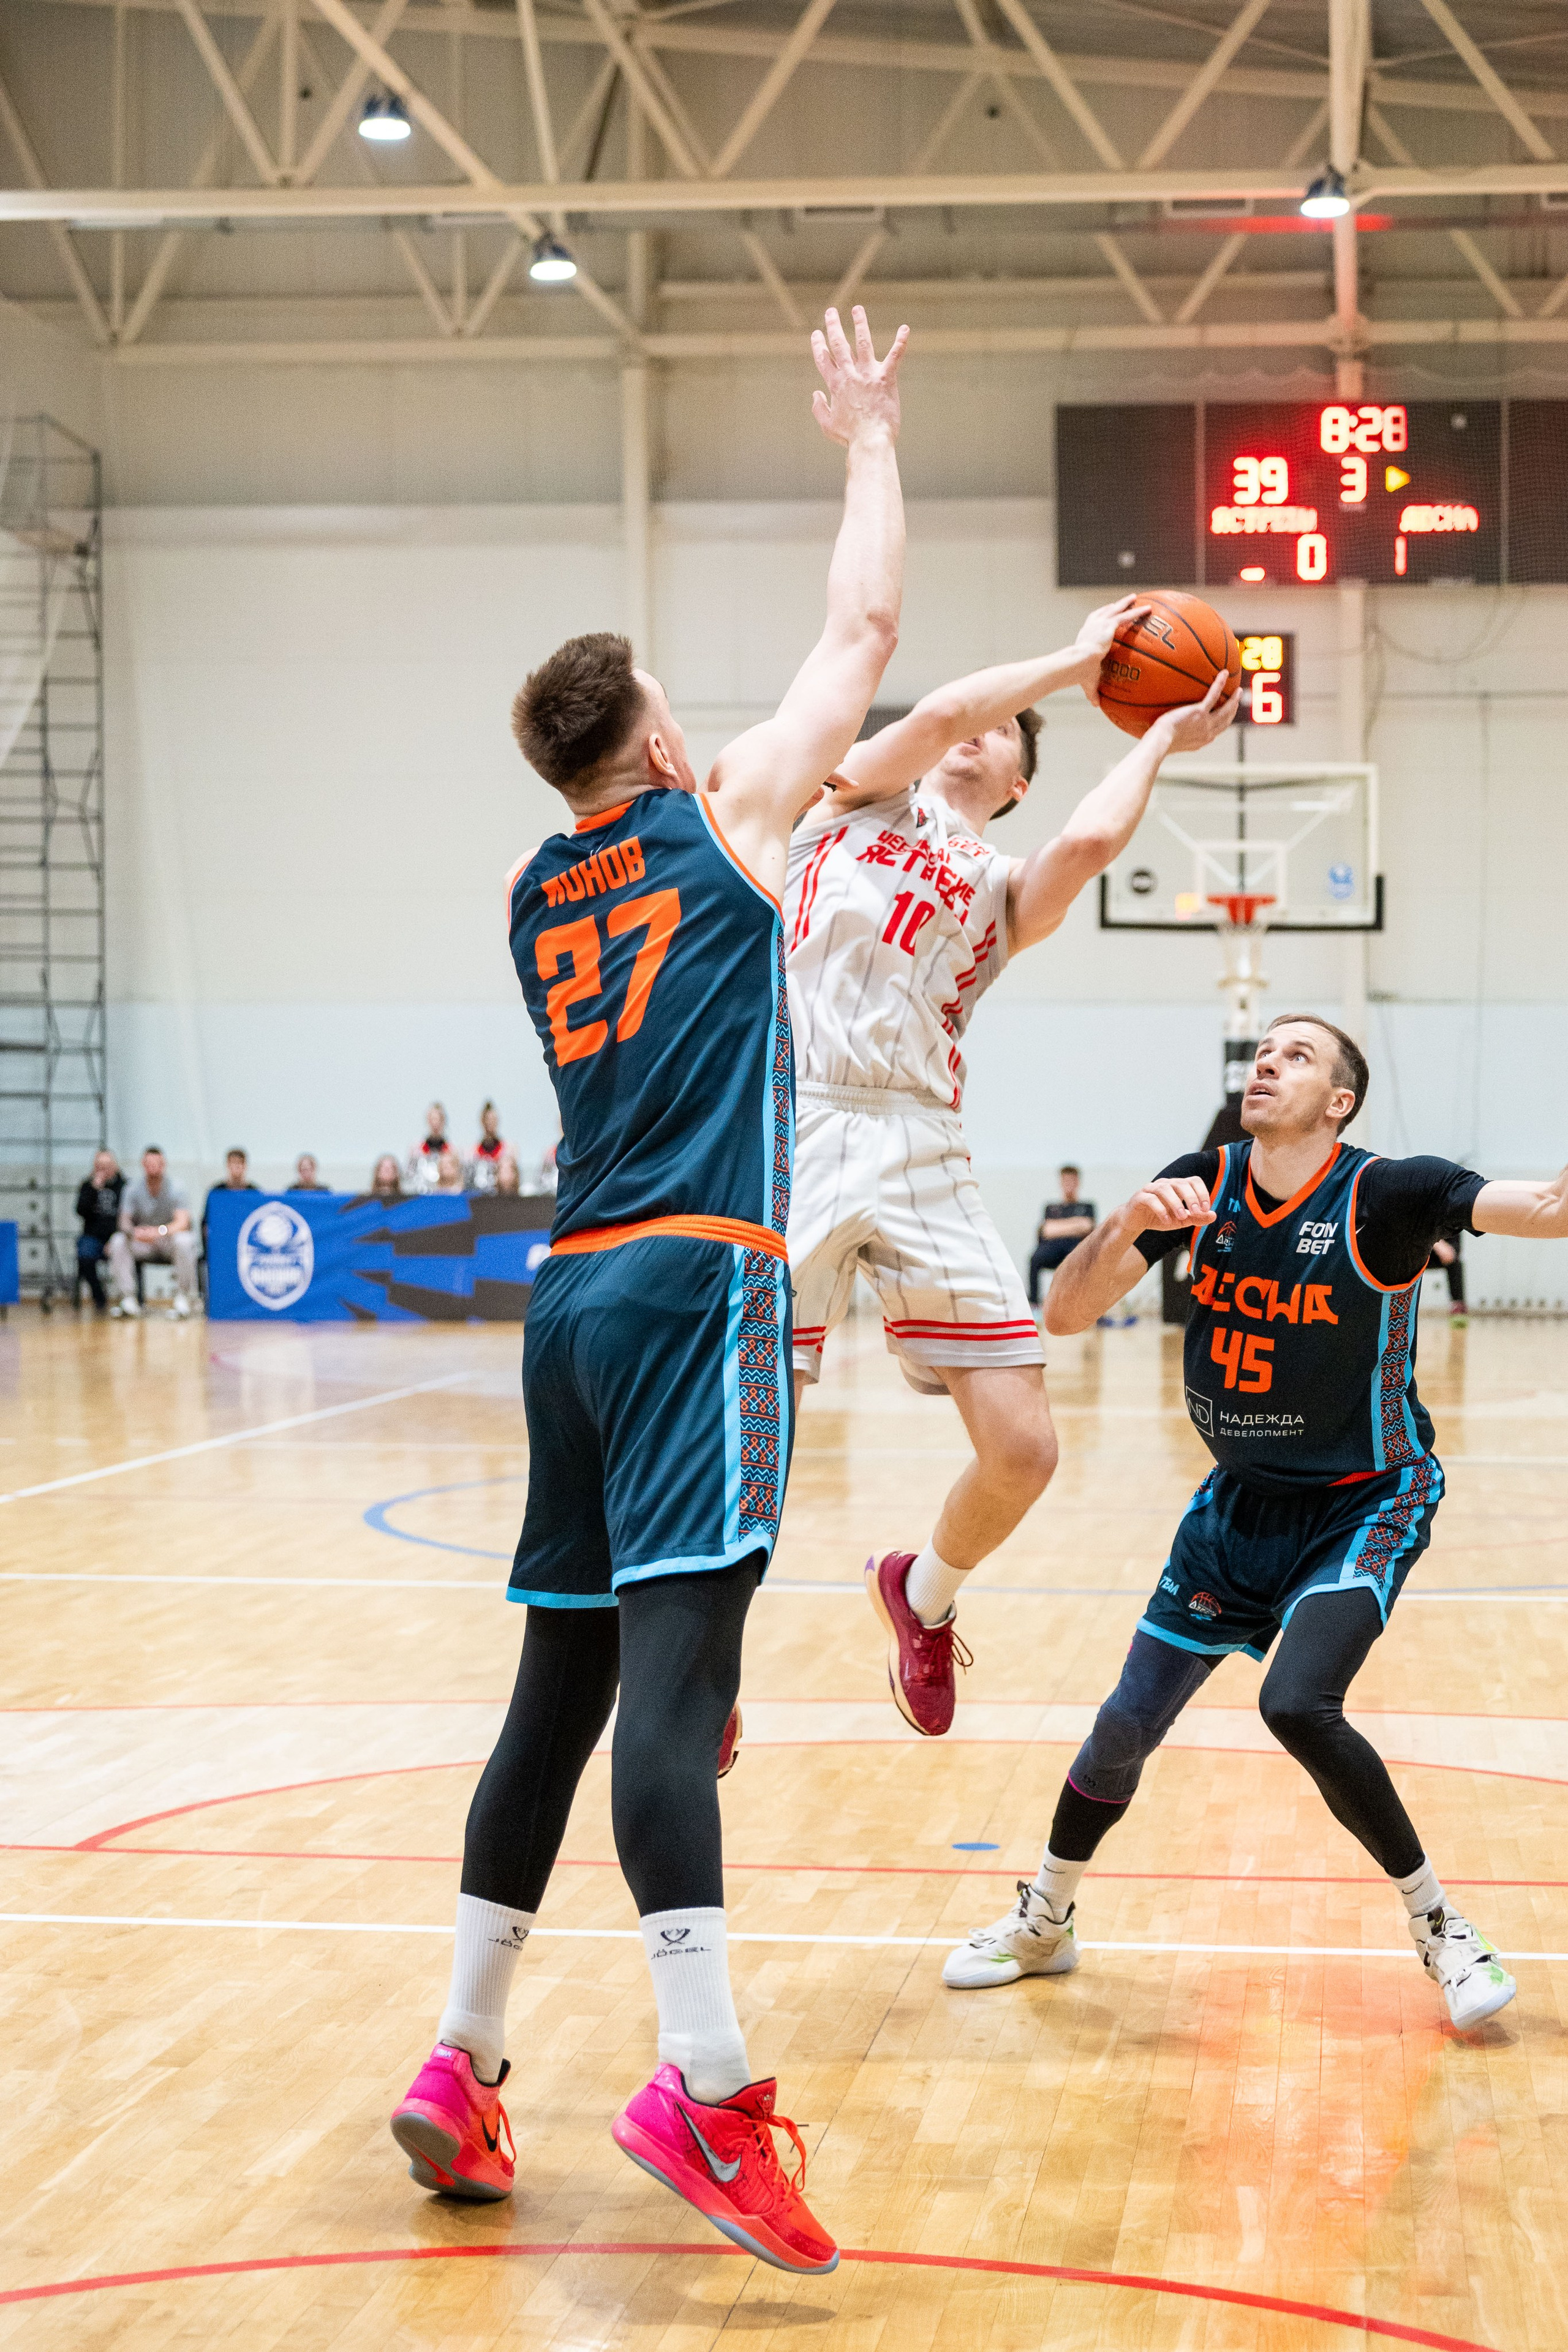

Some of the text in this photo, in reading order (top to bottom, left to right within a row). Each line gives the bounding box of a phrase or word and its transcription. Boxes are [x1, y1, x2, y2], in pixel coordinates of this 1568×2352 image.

[1321, 406, 1408, 453] 8:28
[1233, 456, 1289, 505] 39
[1340, 456, 1367, 503] 3
[1297, 533, 1327, 581] 0
[1395, 535, 1407, 576] 1
[1251, 671, 1284, 724] 6
[882, 891, 935, 956] 10
[535, 887, 682, 1067] 27
[1295, 1238, 1335, 1254] BET
[1298, 1221, 1339, 1237] FON
[1210, 1327, 1275, 1393] 45
[1220, 1411, 1305, 1426] НАДЕЖДА
[1220, 1427, 1305, 1438] ДЕВЕЛОПМЕНТ
